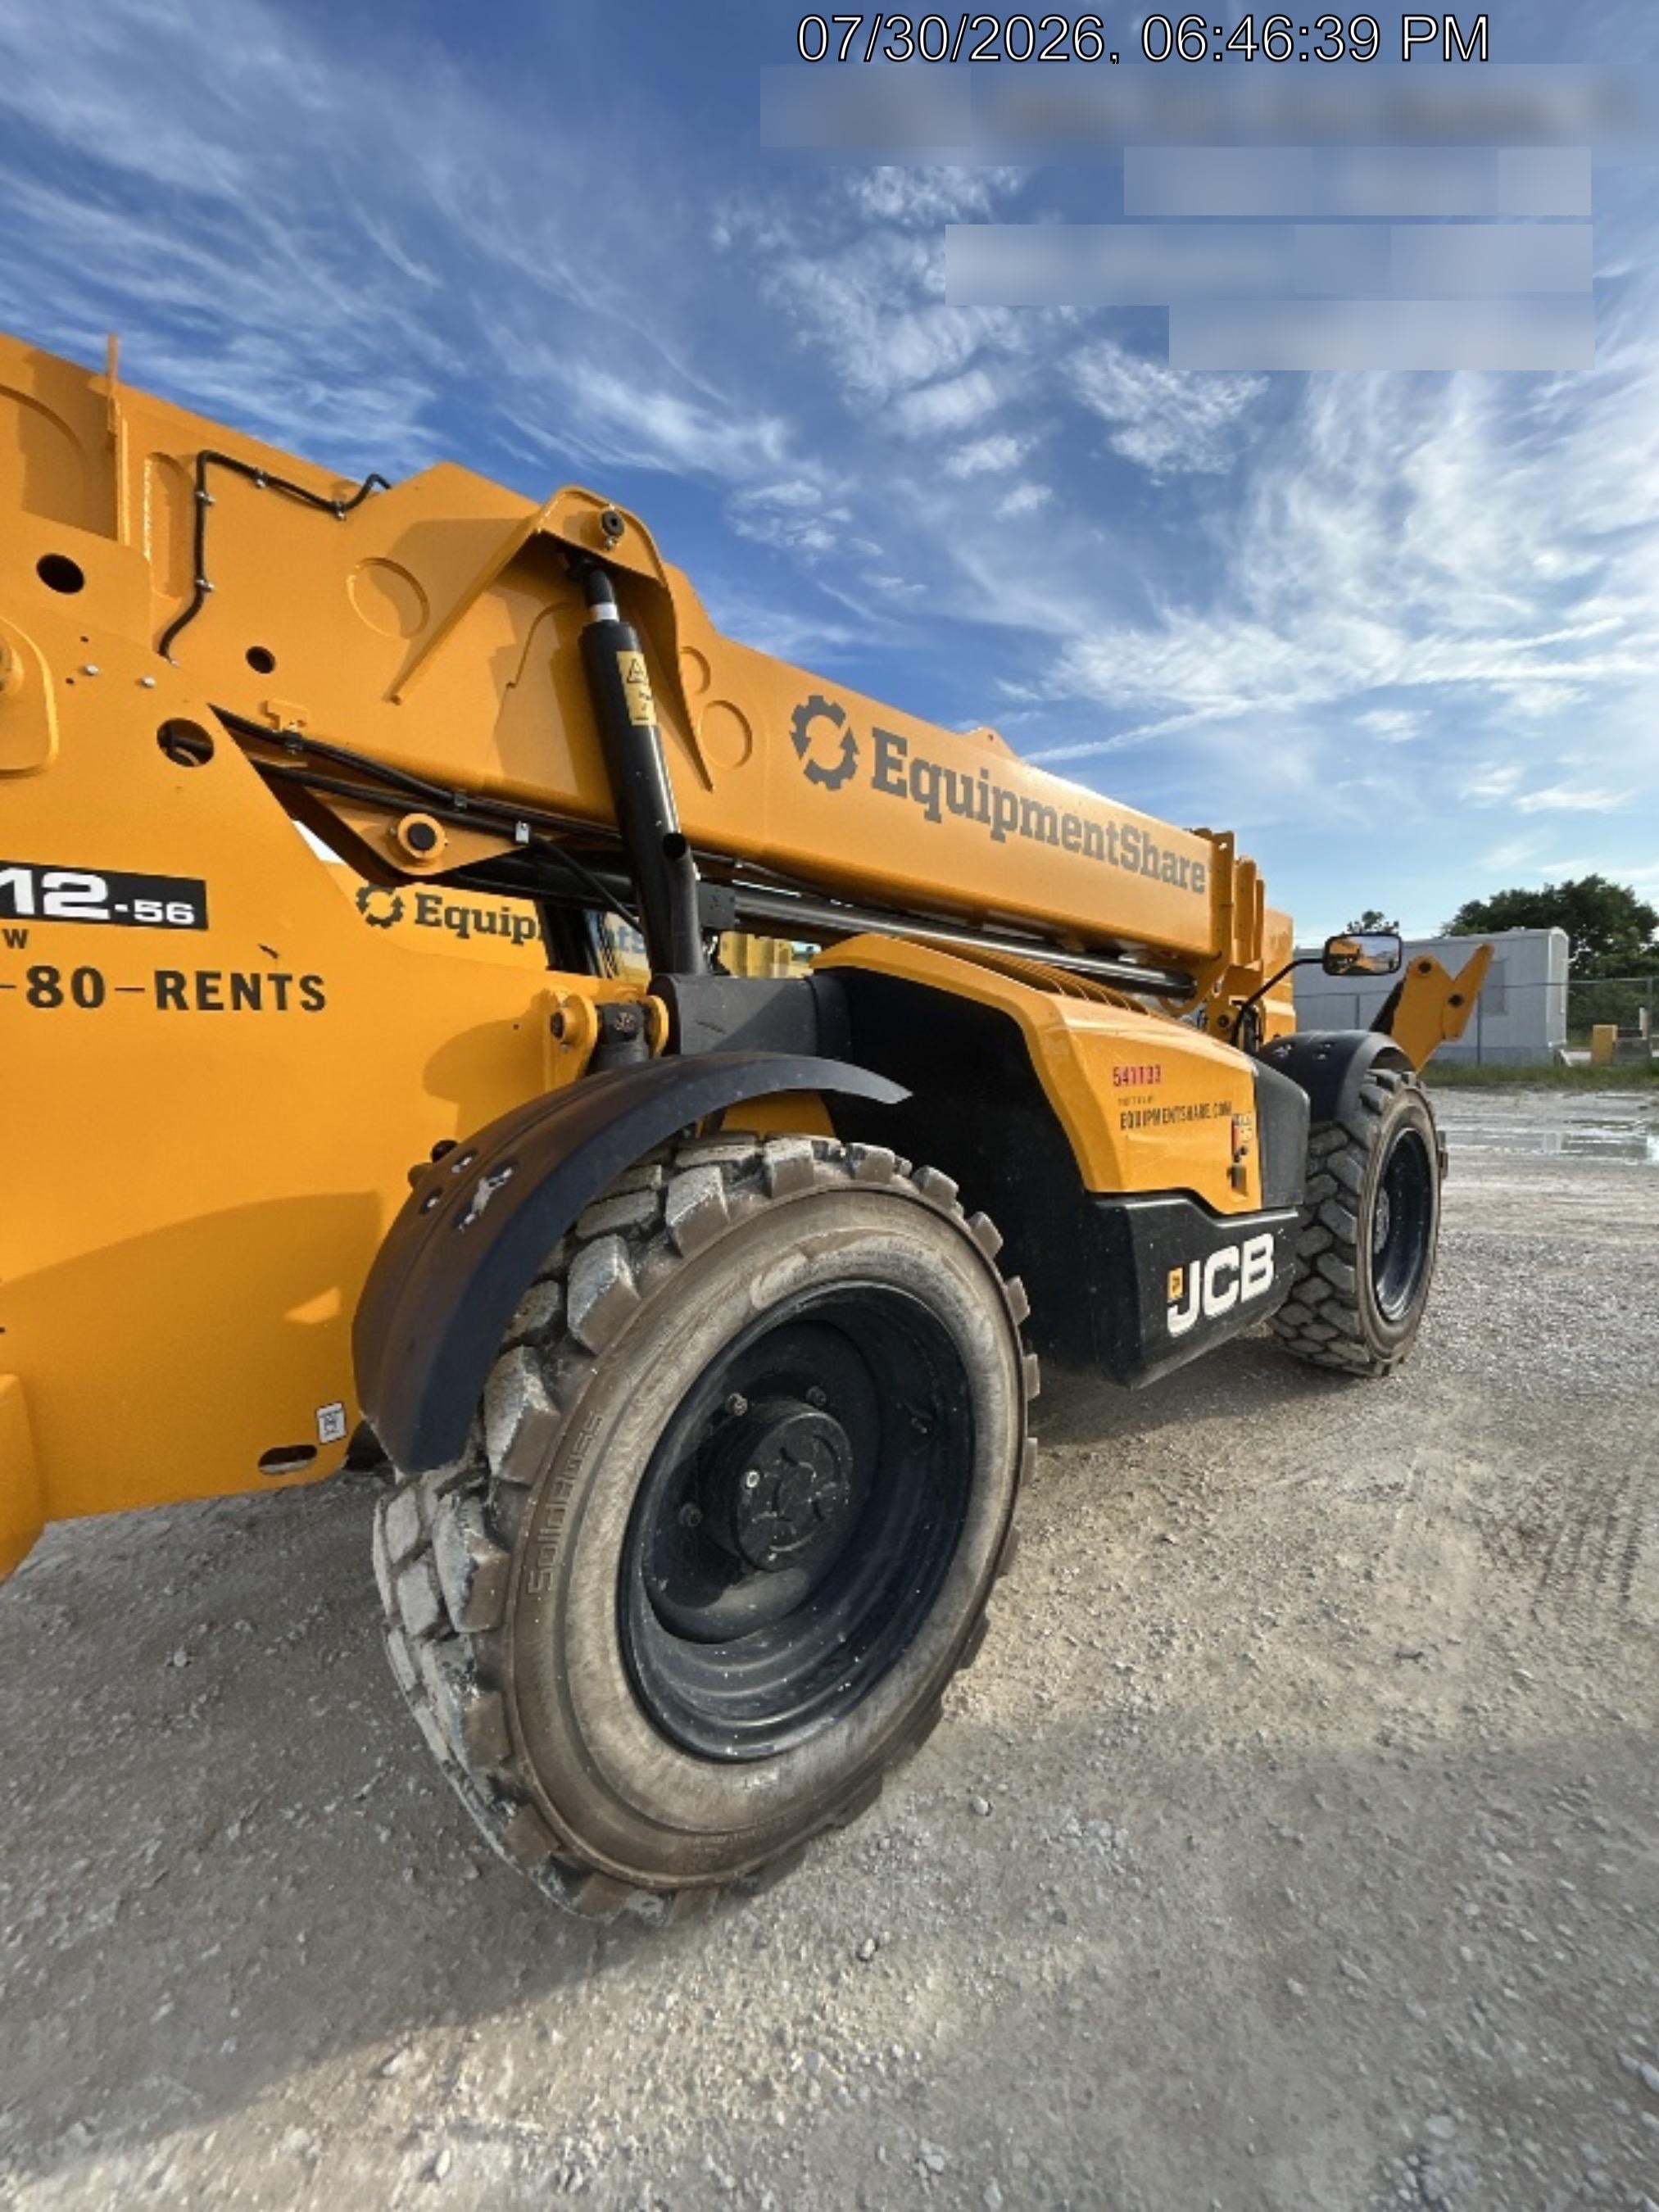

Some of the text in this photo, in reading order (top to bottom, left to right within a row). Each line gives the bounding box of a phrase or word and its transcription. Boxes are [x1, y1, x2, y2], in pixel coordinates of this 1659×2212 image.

[871, 727, 1206, 894] EquipmentShare
[415, 891, 542, 945] Equip
[1167, 1233, 1275, 1338] JCB
